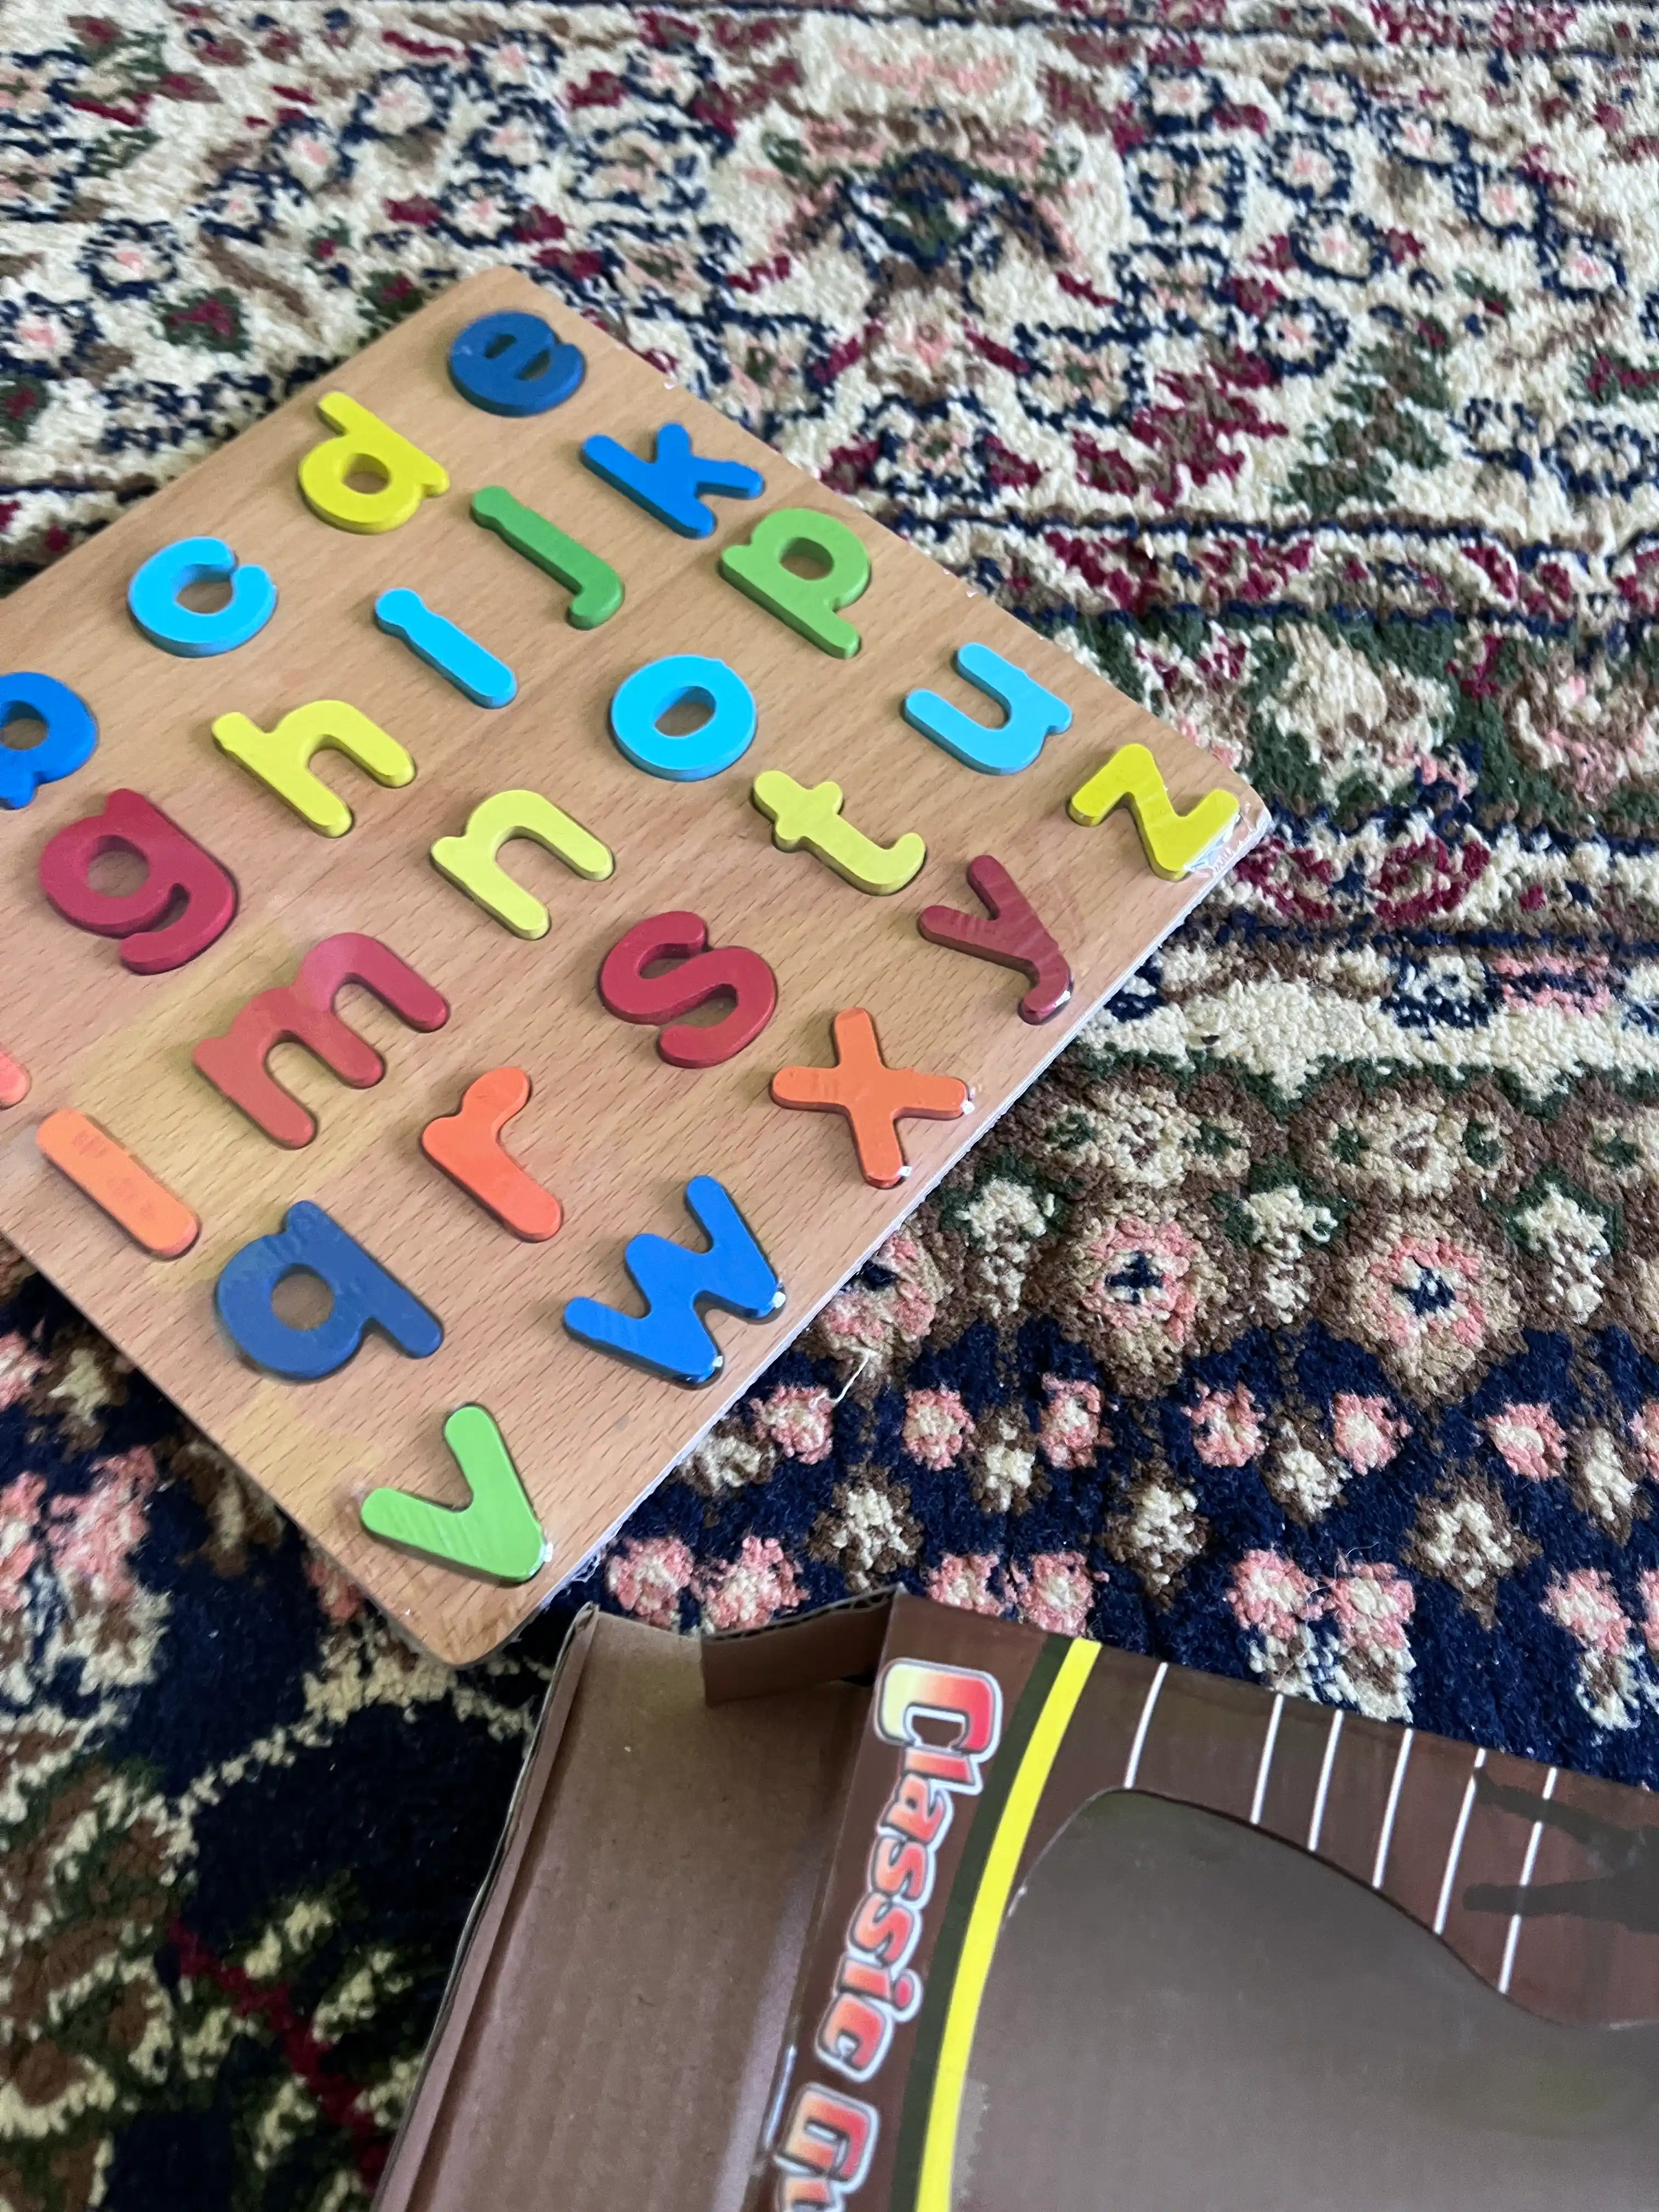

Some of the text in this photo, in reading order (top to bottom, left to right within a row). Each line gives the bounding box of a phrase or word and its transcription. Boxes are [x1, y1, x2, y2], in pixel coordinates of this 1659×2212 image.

[38, 787, 238, 975] g
[211, 699, 415, 837] h
[580, 422, 764, 539] k
[127, 536, 278, 657] c
[298, 391, 450, 534] d
[449, 310, 586, 417] e
[193, 932, 450, 1150] m
[431, 789, 615, 940] n
[610, 654, 758, 782] o
[721, 507, 871, 658] p
[215, 642, 1072, 1384] q r s t u
[360, 743, 1240, 1585] v w x y z
[815, 1657, 1003, 2083] Classic
